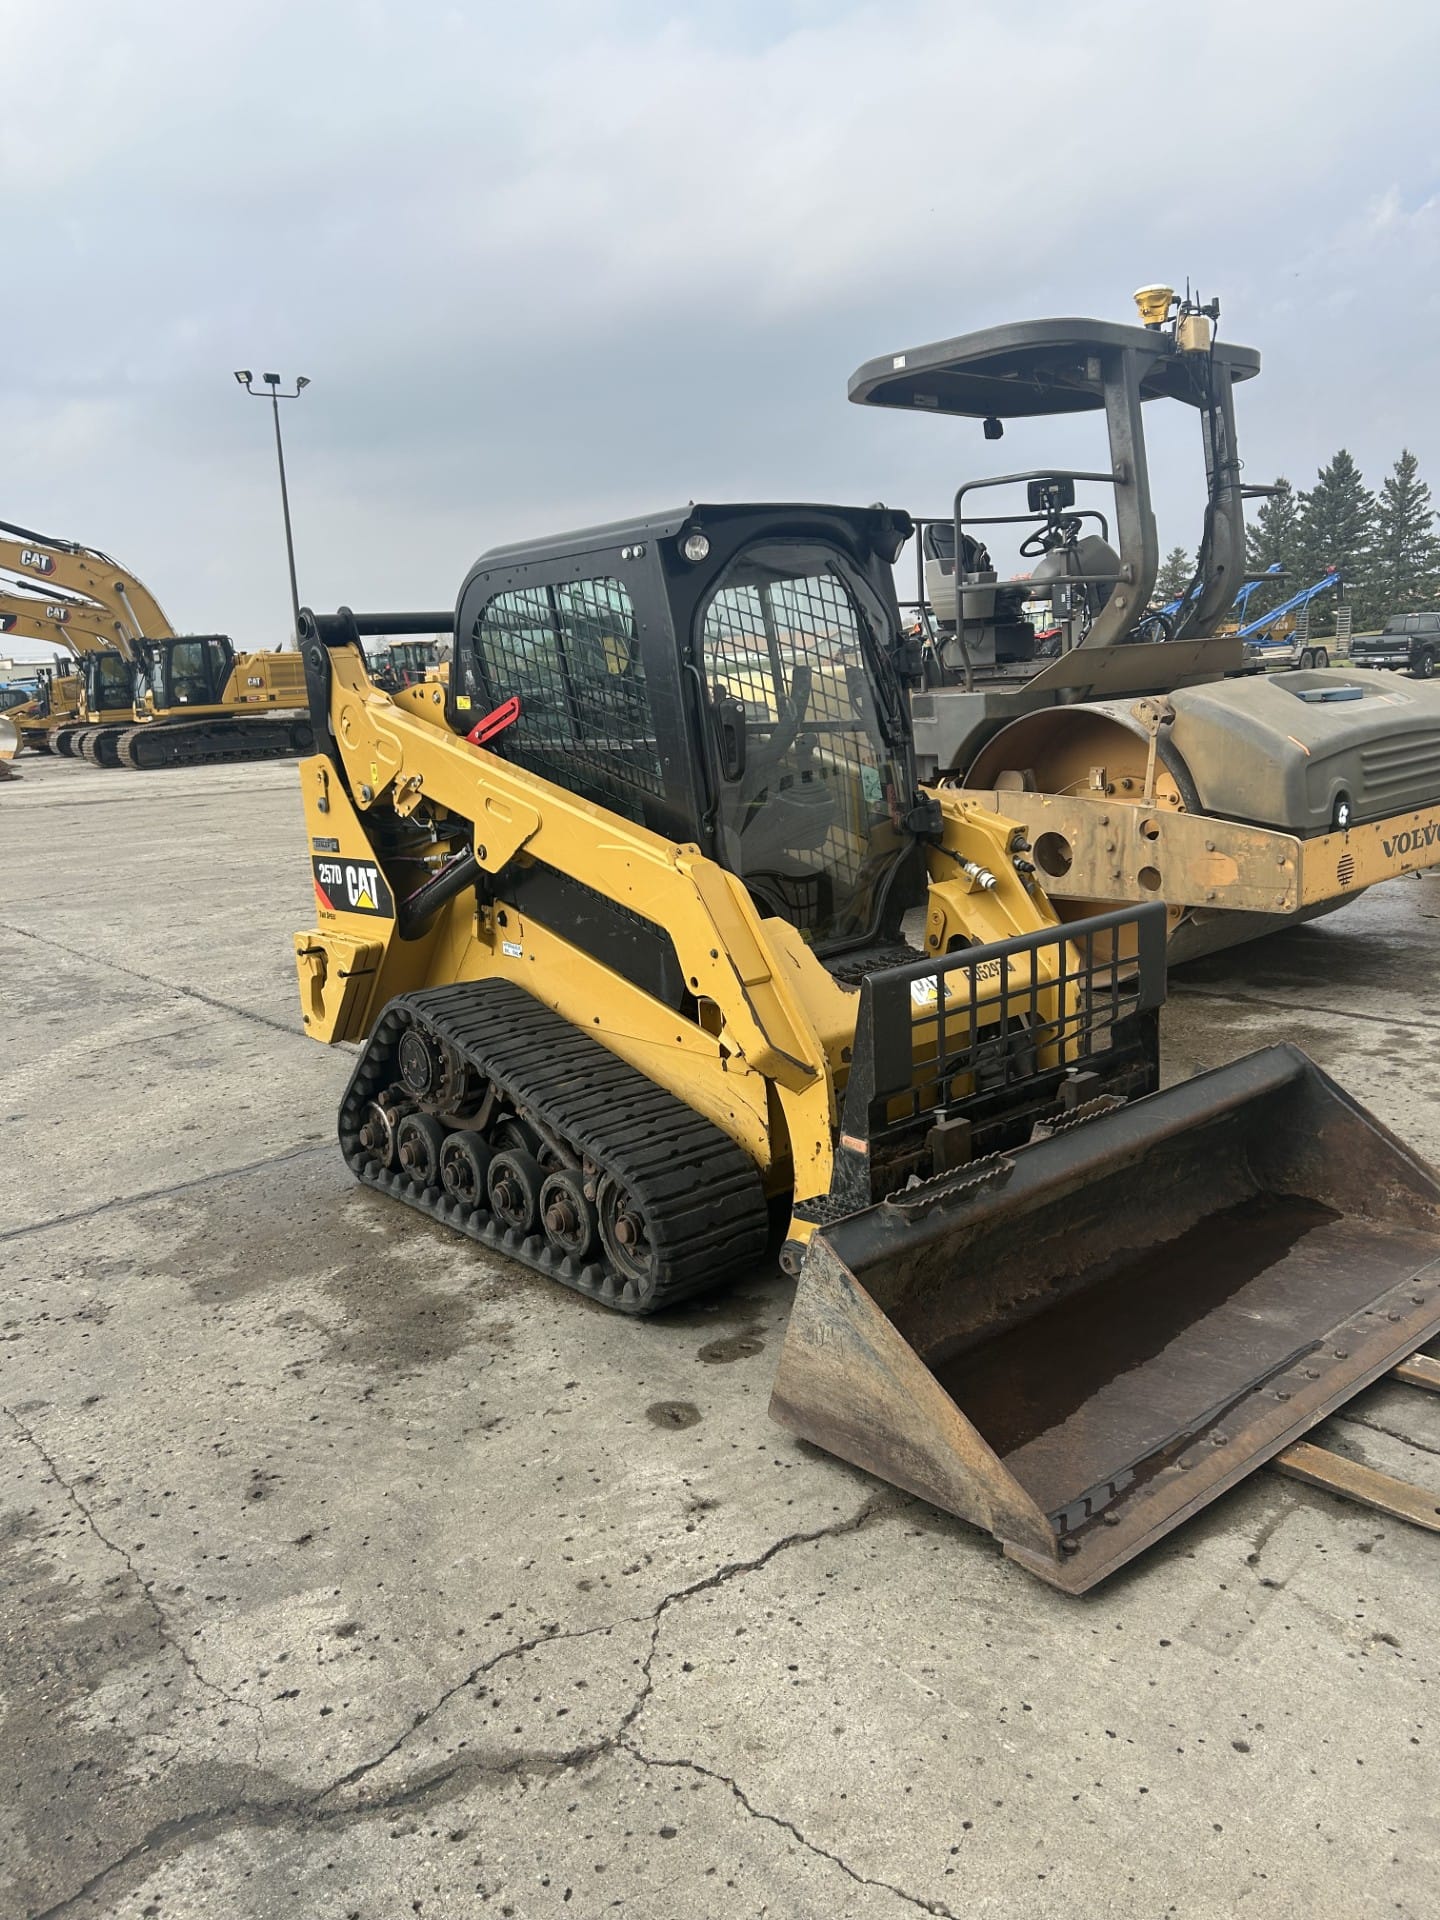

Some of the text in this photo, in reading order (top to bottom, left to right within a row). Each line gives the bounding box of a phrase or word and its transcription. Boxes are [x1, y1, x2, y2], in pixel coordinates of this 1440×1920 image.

[21, 550, 50, 571] CAT
[46, 606, 66, 620] CAT
[247, 677, 261, 687] CAT
[1383, 823, 1440, 858] VOLV
[318, 863, 379, 910] 257D CAT
